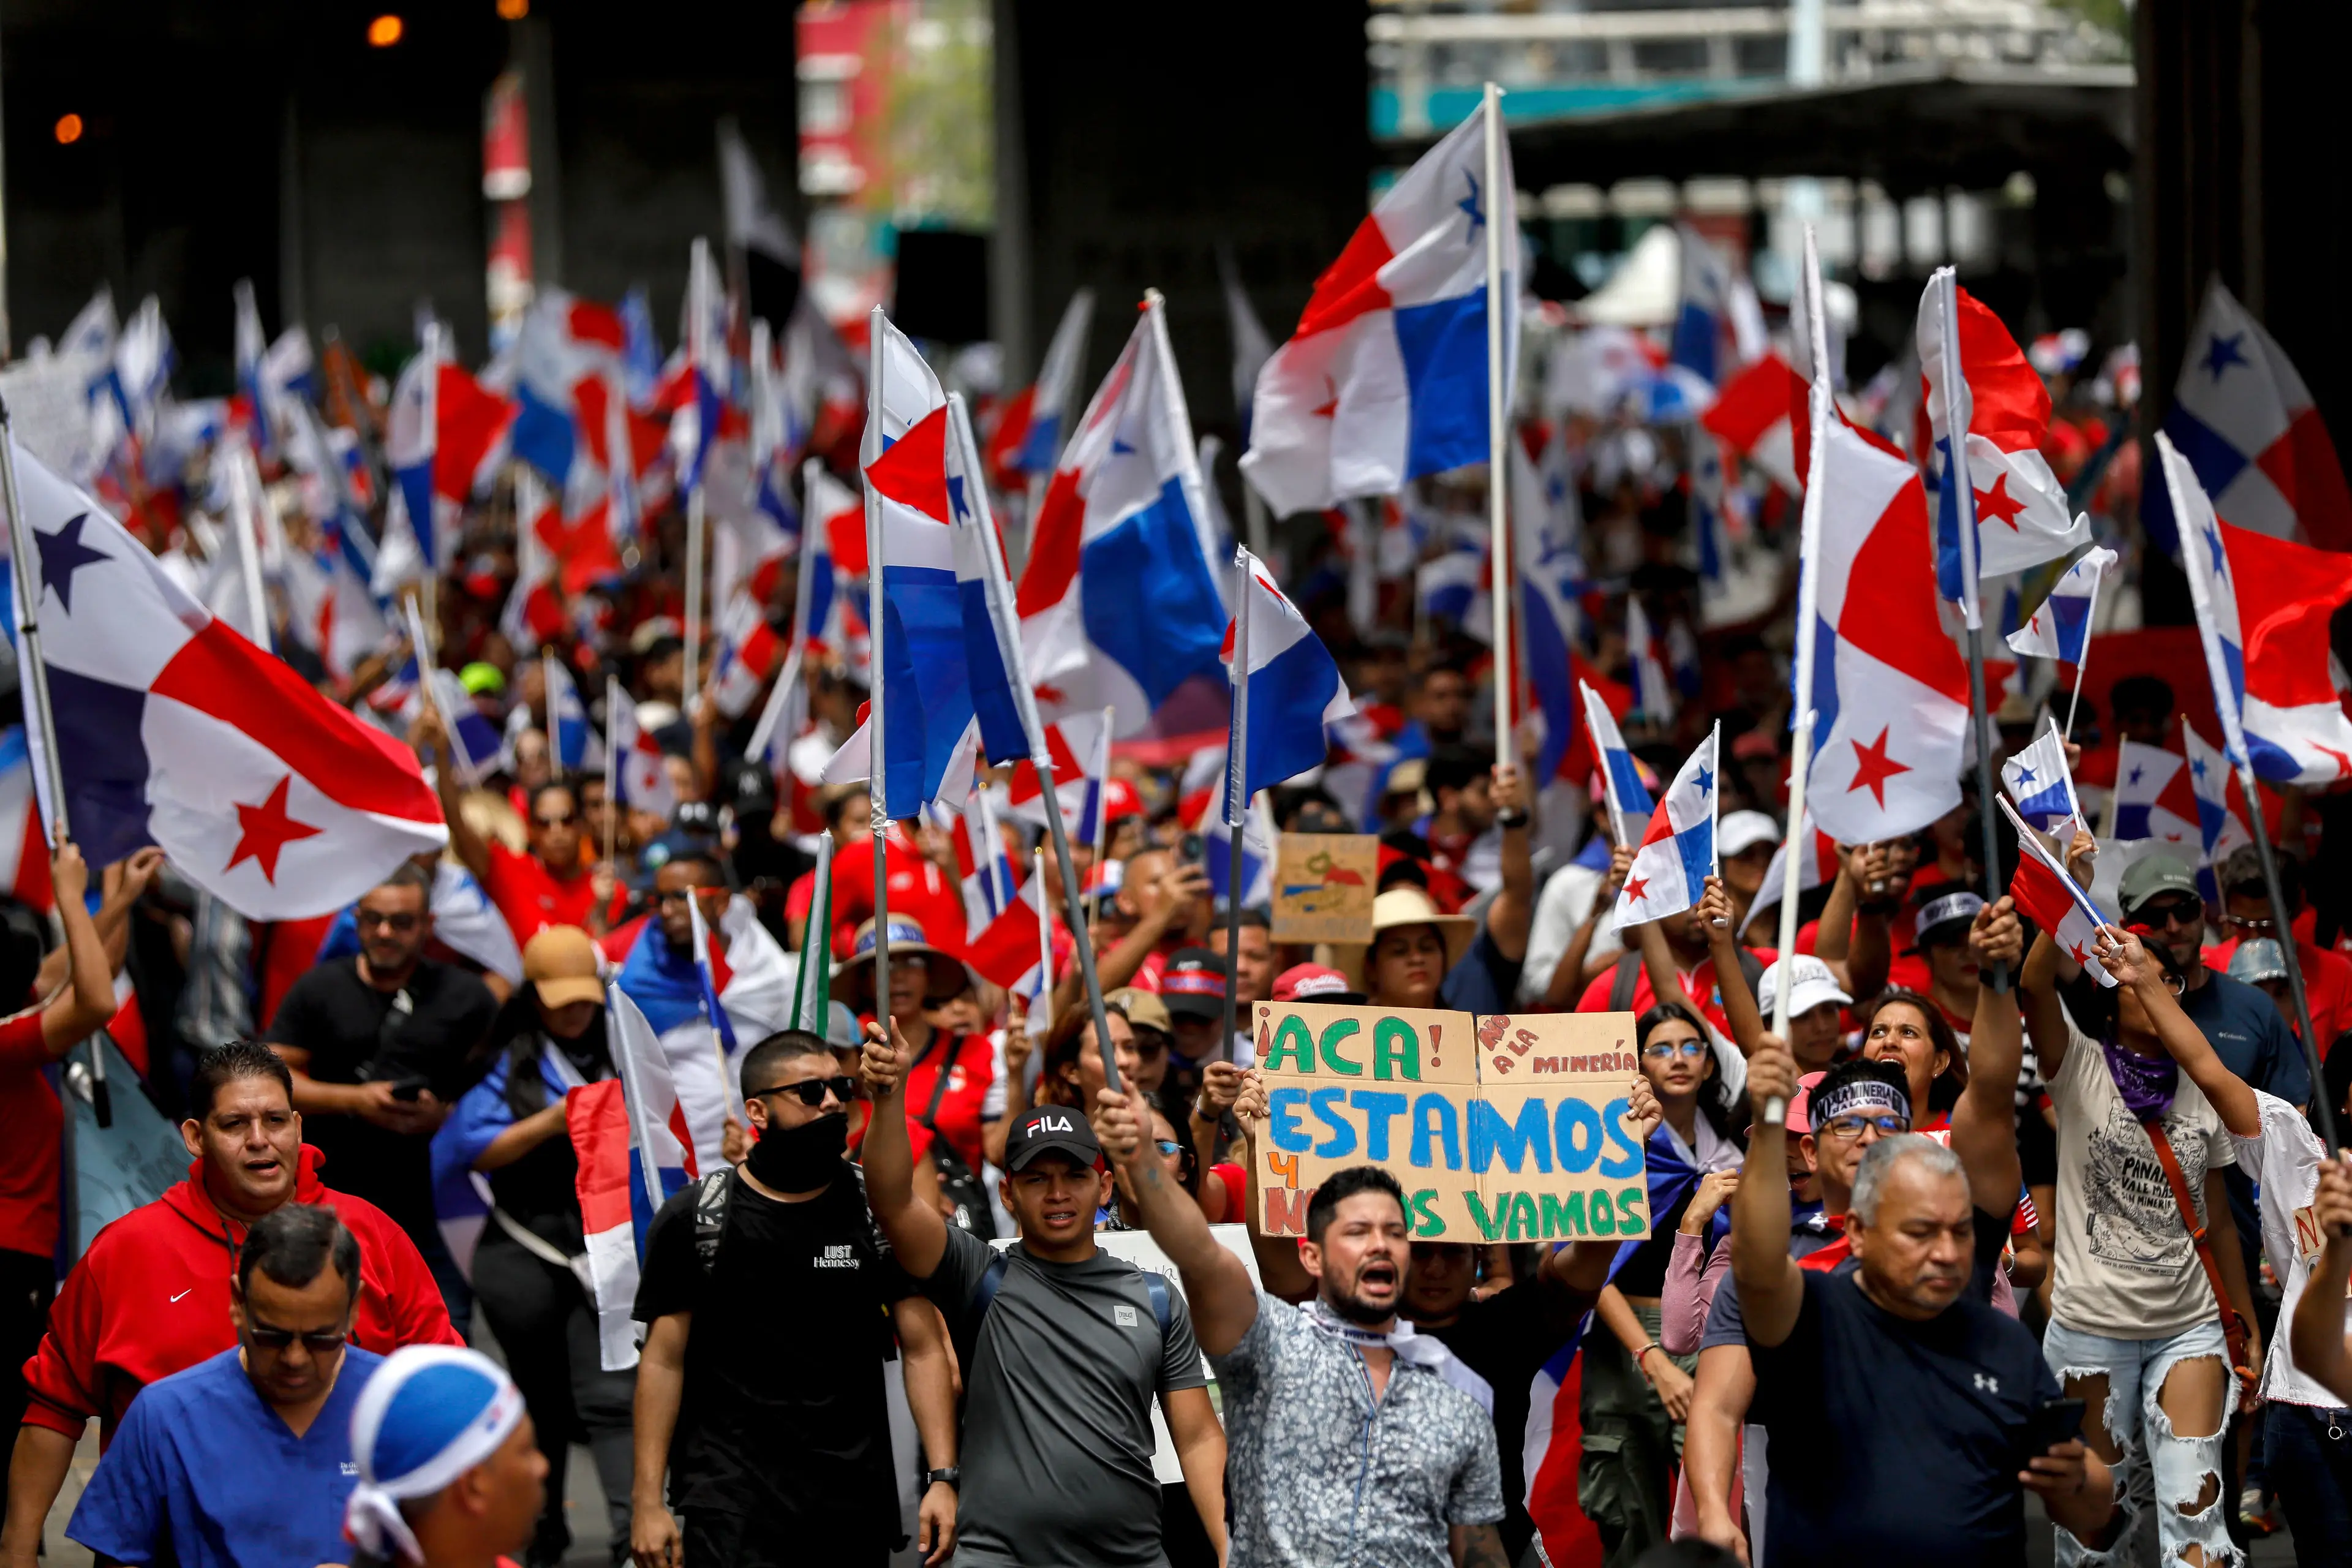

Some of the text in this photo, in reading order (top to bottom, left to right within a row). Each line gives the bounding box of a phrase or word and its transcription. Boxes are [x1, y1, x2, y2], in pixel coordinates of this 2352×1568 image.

[1479, 1015, 1511, 1052] NO
[1492, 1028, 1540, 1075] A LA
[1532, 1039, 1638, 1074] MINERÍA
[1027, 1115, 1073, 1139] FILA
[1268, 1087, 1646, 1180] ESTAMOS
[2122, 1177, 2149, 1194] VALE
[1264, 1186, 1318, 1235] N
[1461, 1188, 1646, 1242] VAMOS
[813, 1256, 861, 1270] Hennessy
[824, 1245, 852, 1259] LUST
